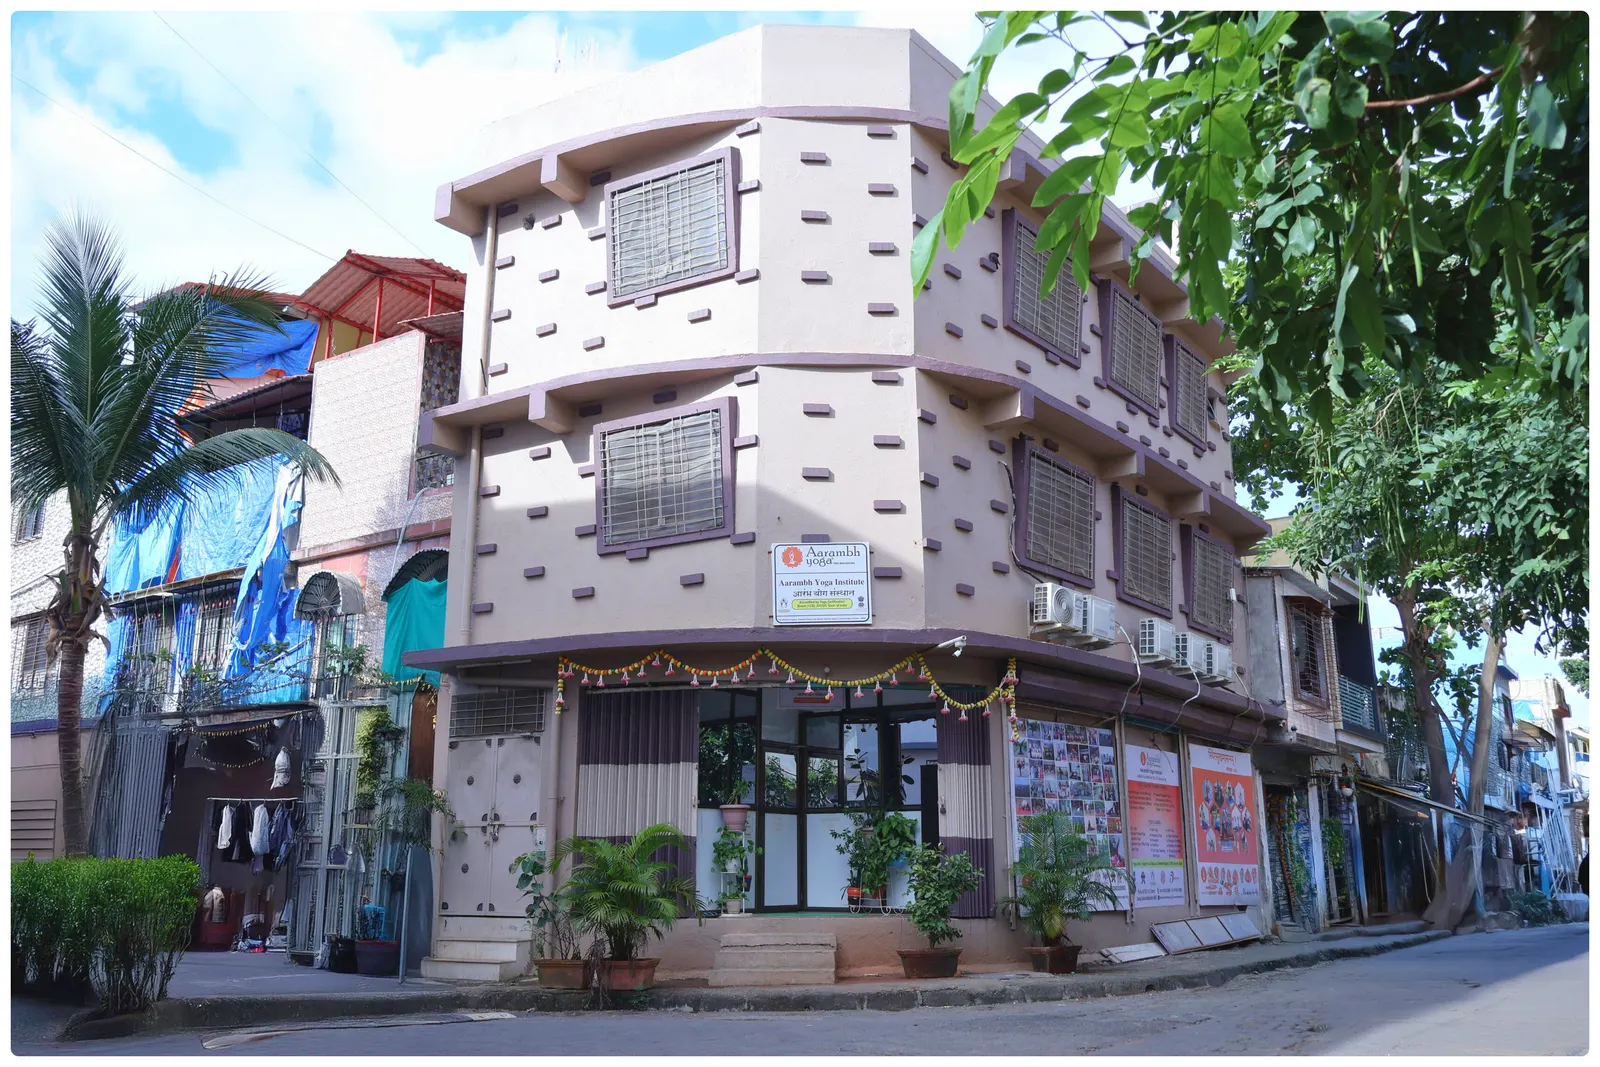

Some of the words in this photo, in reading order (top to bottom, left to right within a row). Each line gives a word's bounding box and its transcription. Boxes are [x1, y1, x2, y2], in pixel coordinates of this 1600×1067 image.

[806, 546, 860, 557] Aarambh
[806, 557, 833, 567] yoga
[779, 579, 813, 587] Aarambh
[814, 579, 833, 587] Yoga
[835, 578, 865, 586] Institute
[793, 588, 812, 598] आरंभ
[813, 588, 828, 597] योग
[829, 587, 855, 597] संस्थान
